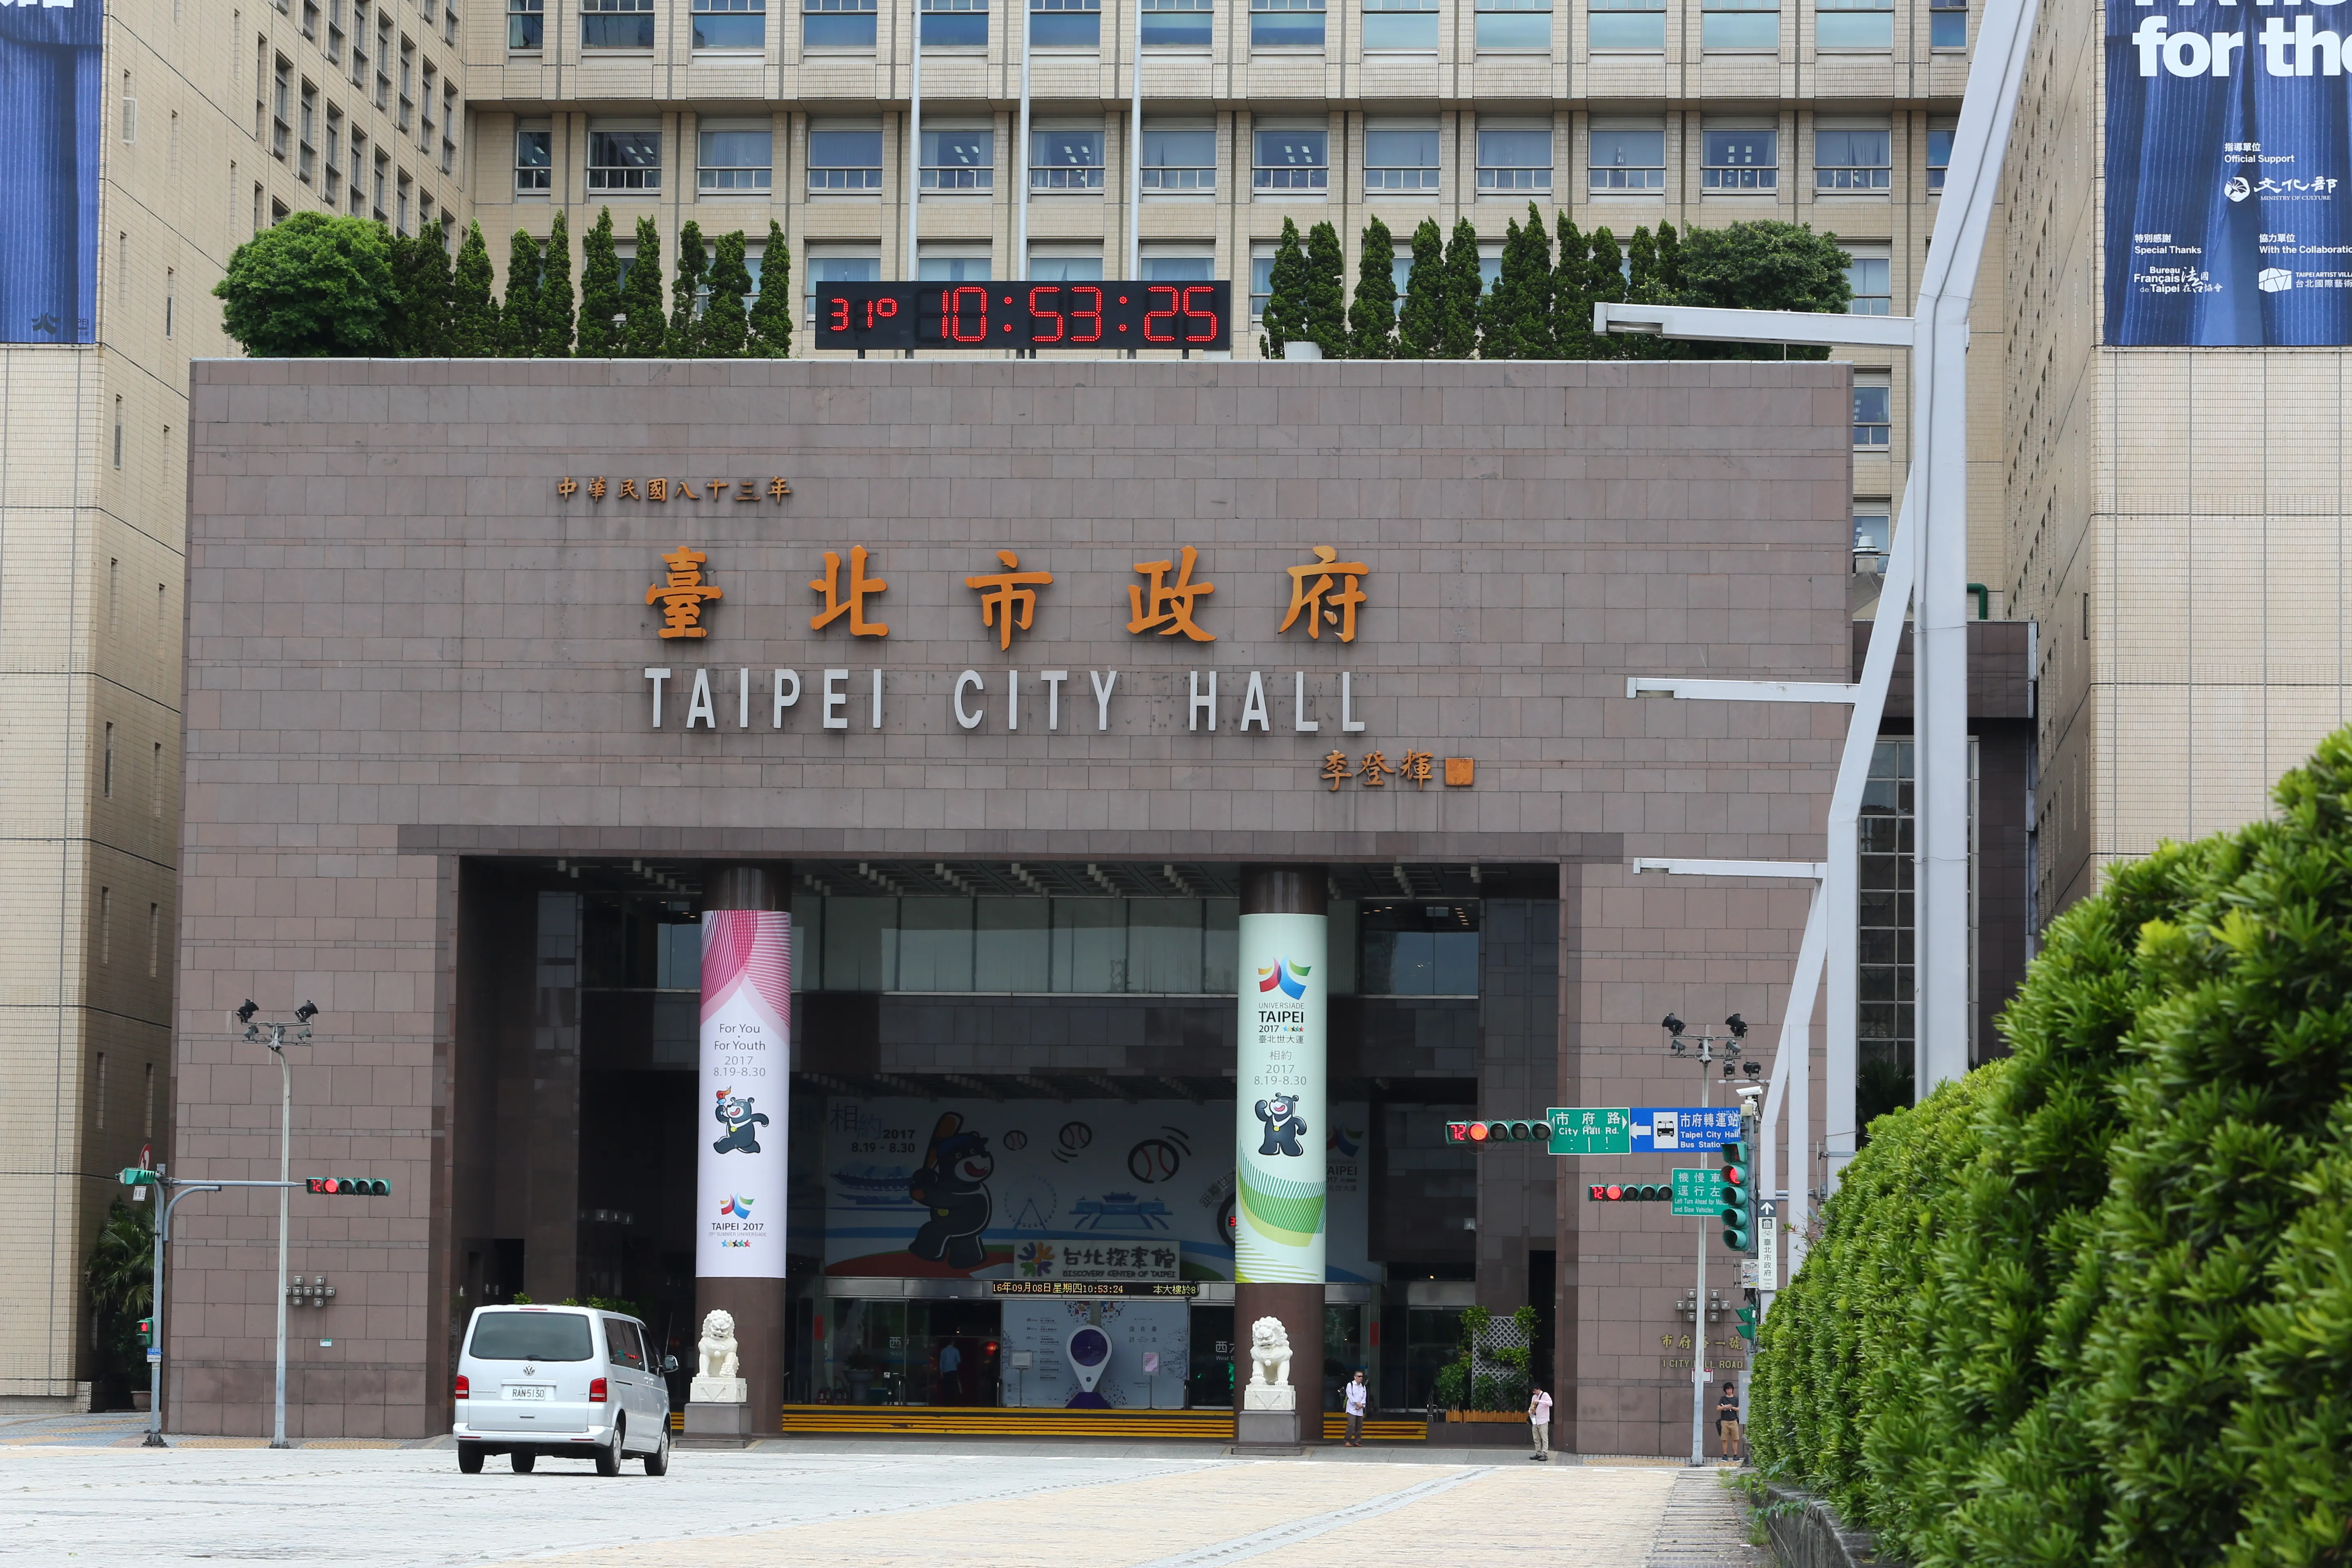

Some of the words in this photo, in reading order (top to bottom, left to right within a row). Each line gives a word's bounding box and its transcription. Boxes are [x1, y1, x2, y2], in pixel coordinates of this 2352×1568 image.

[2132, 15, 2243, 77] for
[2259, 15, 2352, 77] th
[2225, 143, 2261, 152] 指導單位
[2258, 155, 2294, 164] Support
[2254, 176, 2338, 194] 文化部
[2135, 234, 2171, 243] 特別感謝
[2259, 234, 2296, 243] 協力單位
[2135, 246, 2167, 255] Special
[2259, 245, 2280, 254] With
[2282, 245, 2297, 254] the
[2134, 274, 2180, 285] Français
[2150, 284, 2180, 294] Taipei
[942, 286, 1217, 342] 10:53:25
[557, 476, 791, 505] 中華民國八十三年
[645, 545, 1369, 652] 臺北市政府
[645, 668, 882, 729] TAIPEI
[954, 669, 1117, 731] CITY
[1190, 670, 1365, 732] HALL
[1321, 748, 1434, 791] 李登輝
[1258, 1011, 1304, 1022] TAIPEI
[719, 1024, 736, 1033] For
[739, 1024, 760, 1033] You
[1258, 1035, 1304, 1044] 臺北世大運
[715, 1040, 730, 1050] For
[733, 1040, 766, 1050] Youth
[1269, 1050, 1292, 1060] 相約
[725, 1056, 753, 1065] 2017
[713, 1067, 766, 1077] 8.19-8.30
[1266, 1064, 1294, 1074] 2017
[1254, 1076, 1307, 1085] 8.19-8.30
[1556, 1111, 1621, 1125] 市府路
[1680, 1113, 1740, 1127] 市府轉運站
[883, 1129, 915, 1139] 2017
[1450, 1125, 1466, 1140] 72
[1559, 1127, 1578, 1137] City
[1680, 1131, 1703, 1139] Taipei
[1706, 1131, 1721, 1139] City
[852, 1142, 876, 1152] 8.19
[889, 1143, 915, 1153] 8.30
[1678, 1172, 1720, 1183] 機慢車
[311, 1179, 321, 1192] 72
[1592, 1187, 1604, 1199] 72
[1678, 1185, 1720, 1197] 逕行左
[1064, 1246, 1176, 1268] 台北探索館
[1764, 1239, 1772, 1276] 臺北市政府
[1693, 1360, 1715, 1368] LL
[512, 1389, 544, 1398] RAN-5130
